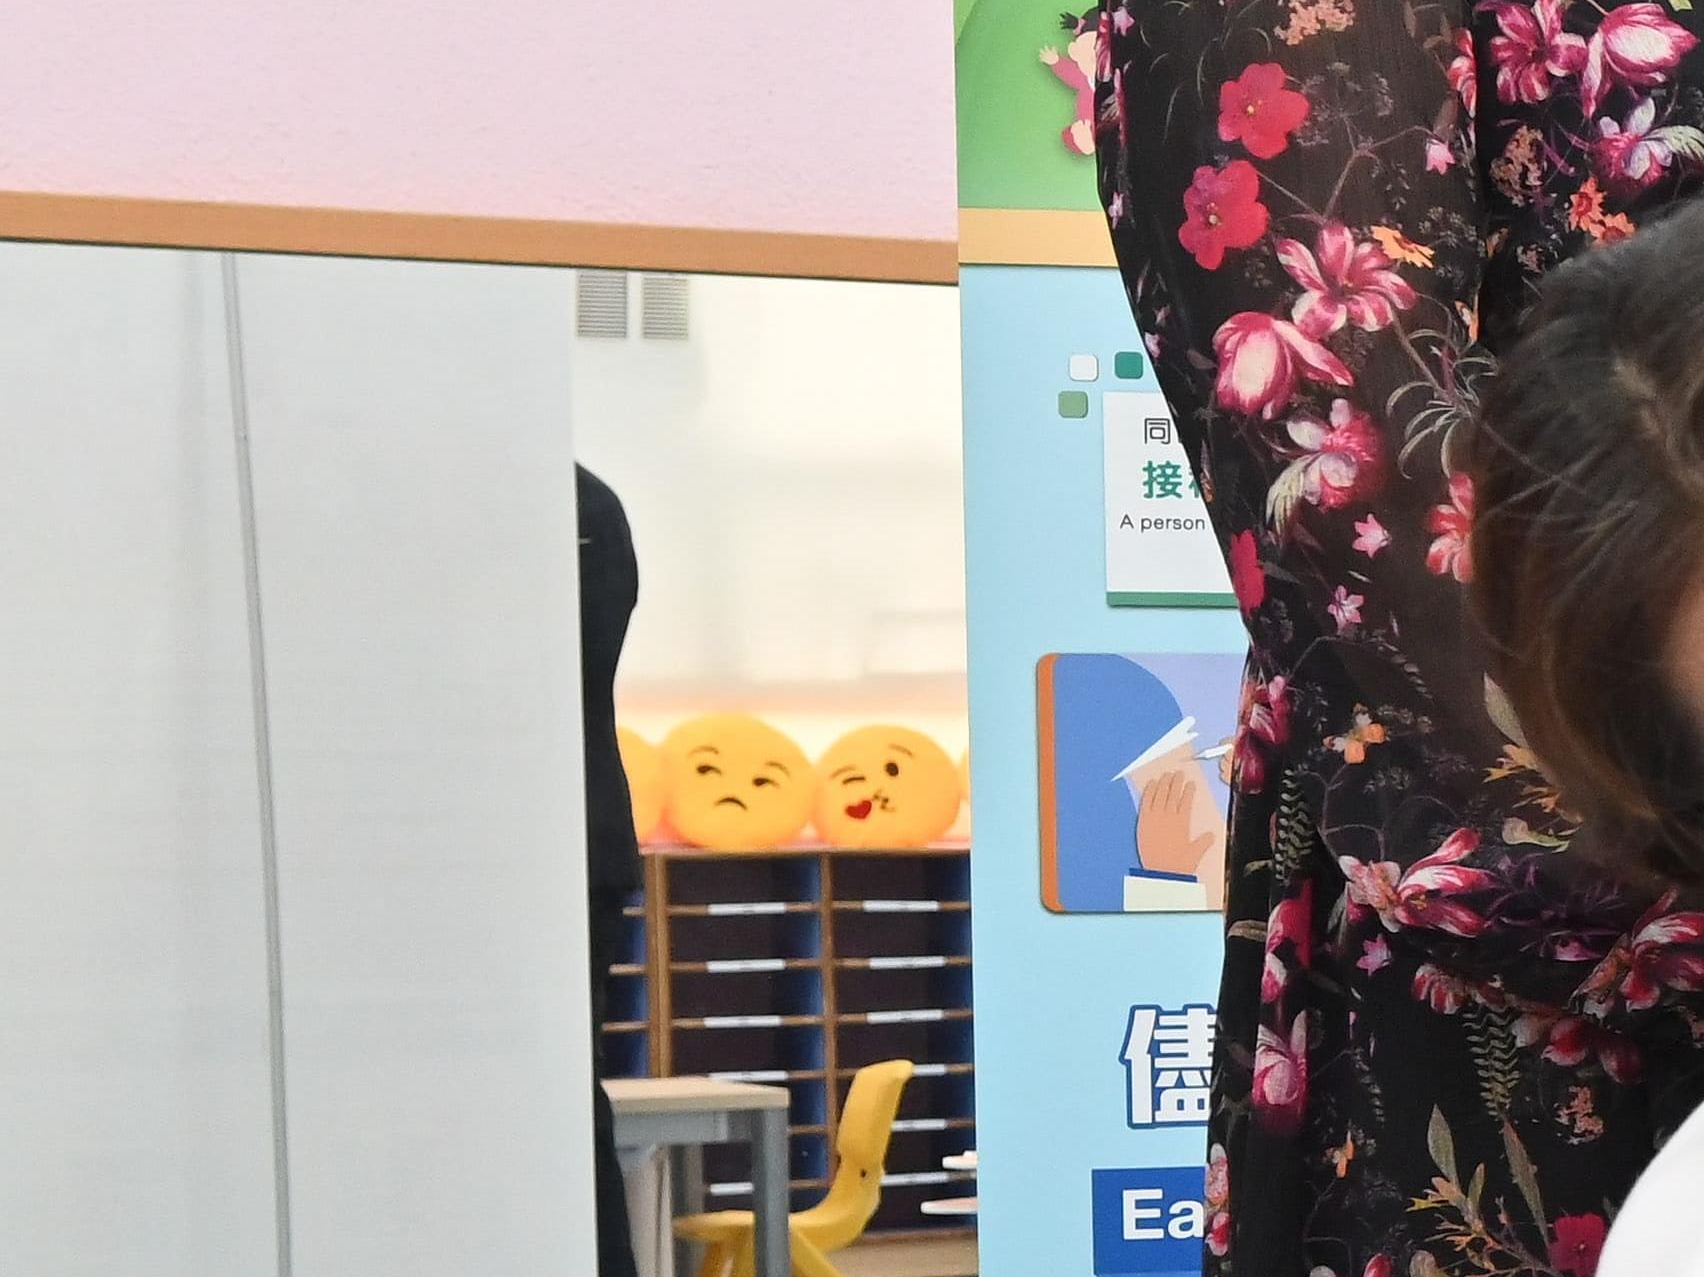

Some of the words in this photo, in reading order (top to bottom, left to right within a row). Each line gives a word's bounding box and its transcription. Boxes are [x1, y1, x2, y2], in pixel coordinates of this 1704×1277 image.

[1142, 460, 1200, 499] 接
[1120, 514, 1134, 529] A
[1141, 518, 1205, 533] person
[1122, 1188, 1204, 1240] Ea
